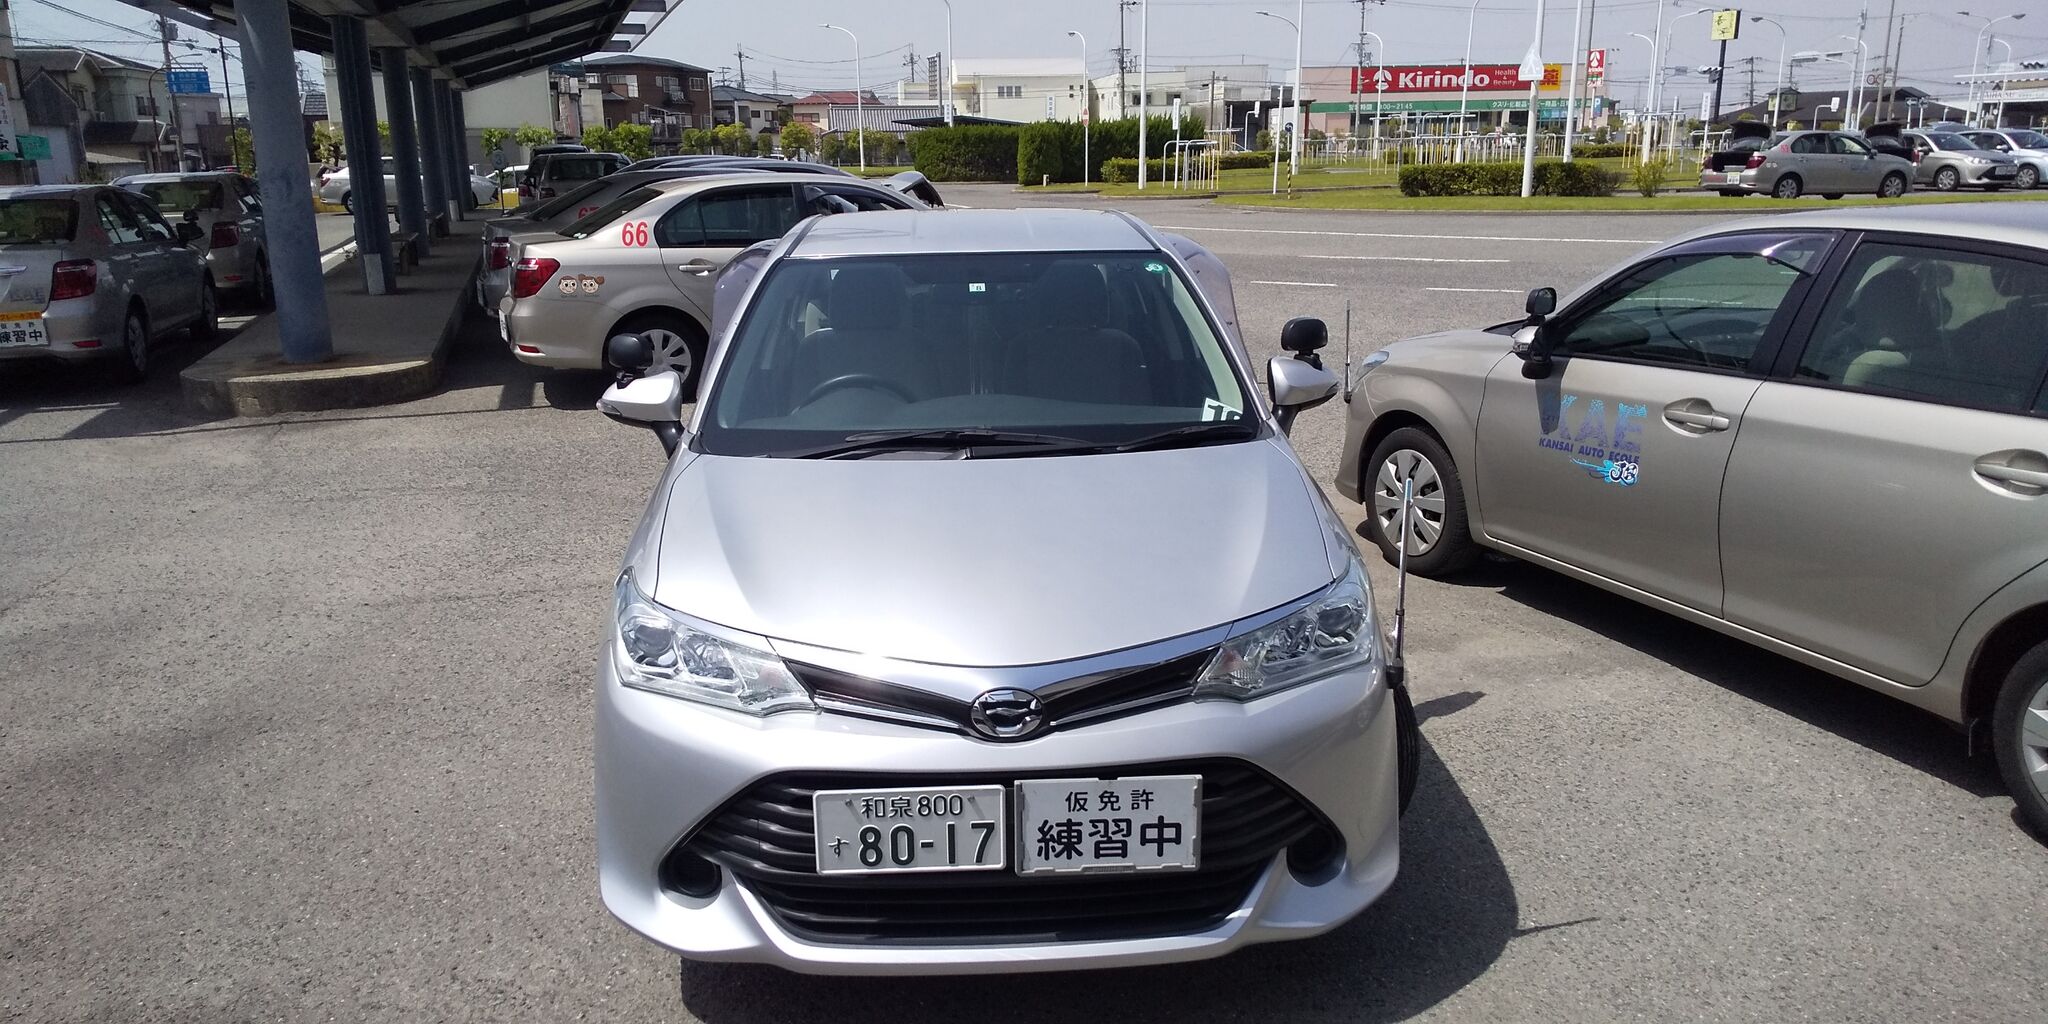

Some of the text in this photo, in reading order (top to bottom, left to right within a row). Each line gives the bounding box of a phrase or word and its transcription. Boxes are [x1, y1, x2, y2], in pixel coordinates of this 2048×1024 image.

[1399, 70, 1490, 88] Kirindo
[1493, 79, 1517, 87] Beauty
[1494, 68, 1517, 76] Health
[1594, 97, 1601, 108] P
[621, 221, 649, 248] 66
[1538, 437, 1640, 464] KANSAI AUTO ECOLE
[861, 793, 963, 819] 和泉800
[1065, 788, 1155, 813] 仮免許
[828, 820, 996, 867] す 80-17
[1036, 815, 1183, 861] 練習中
